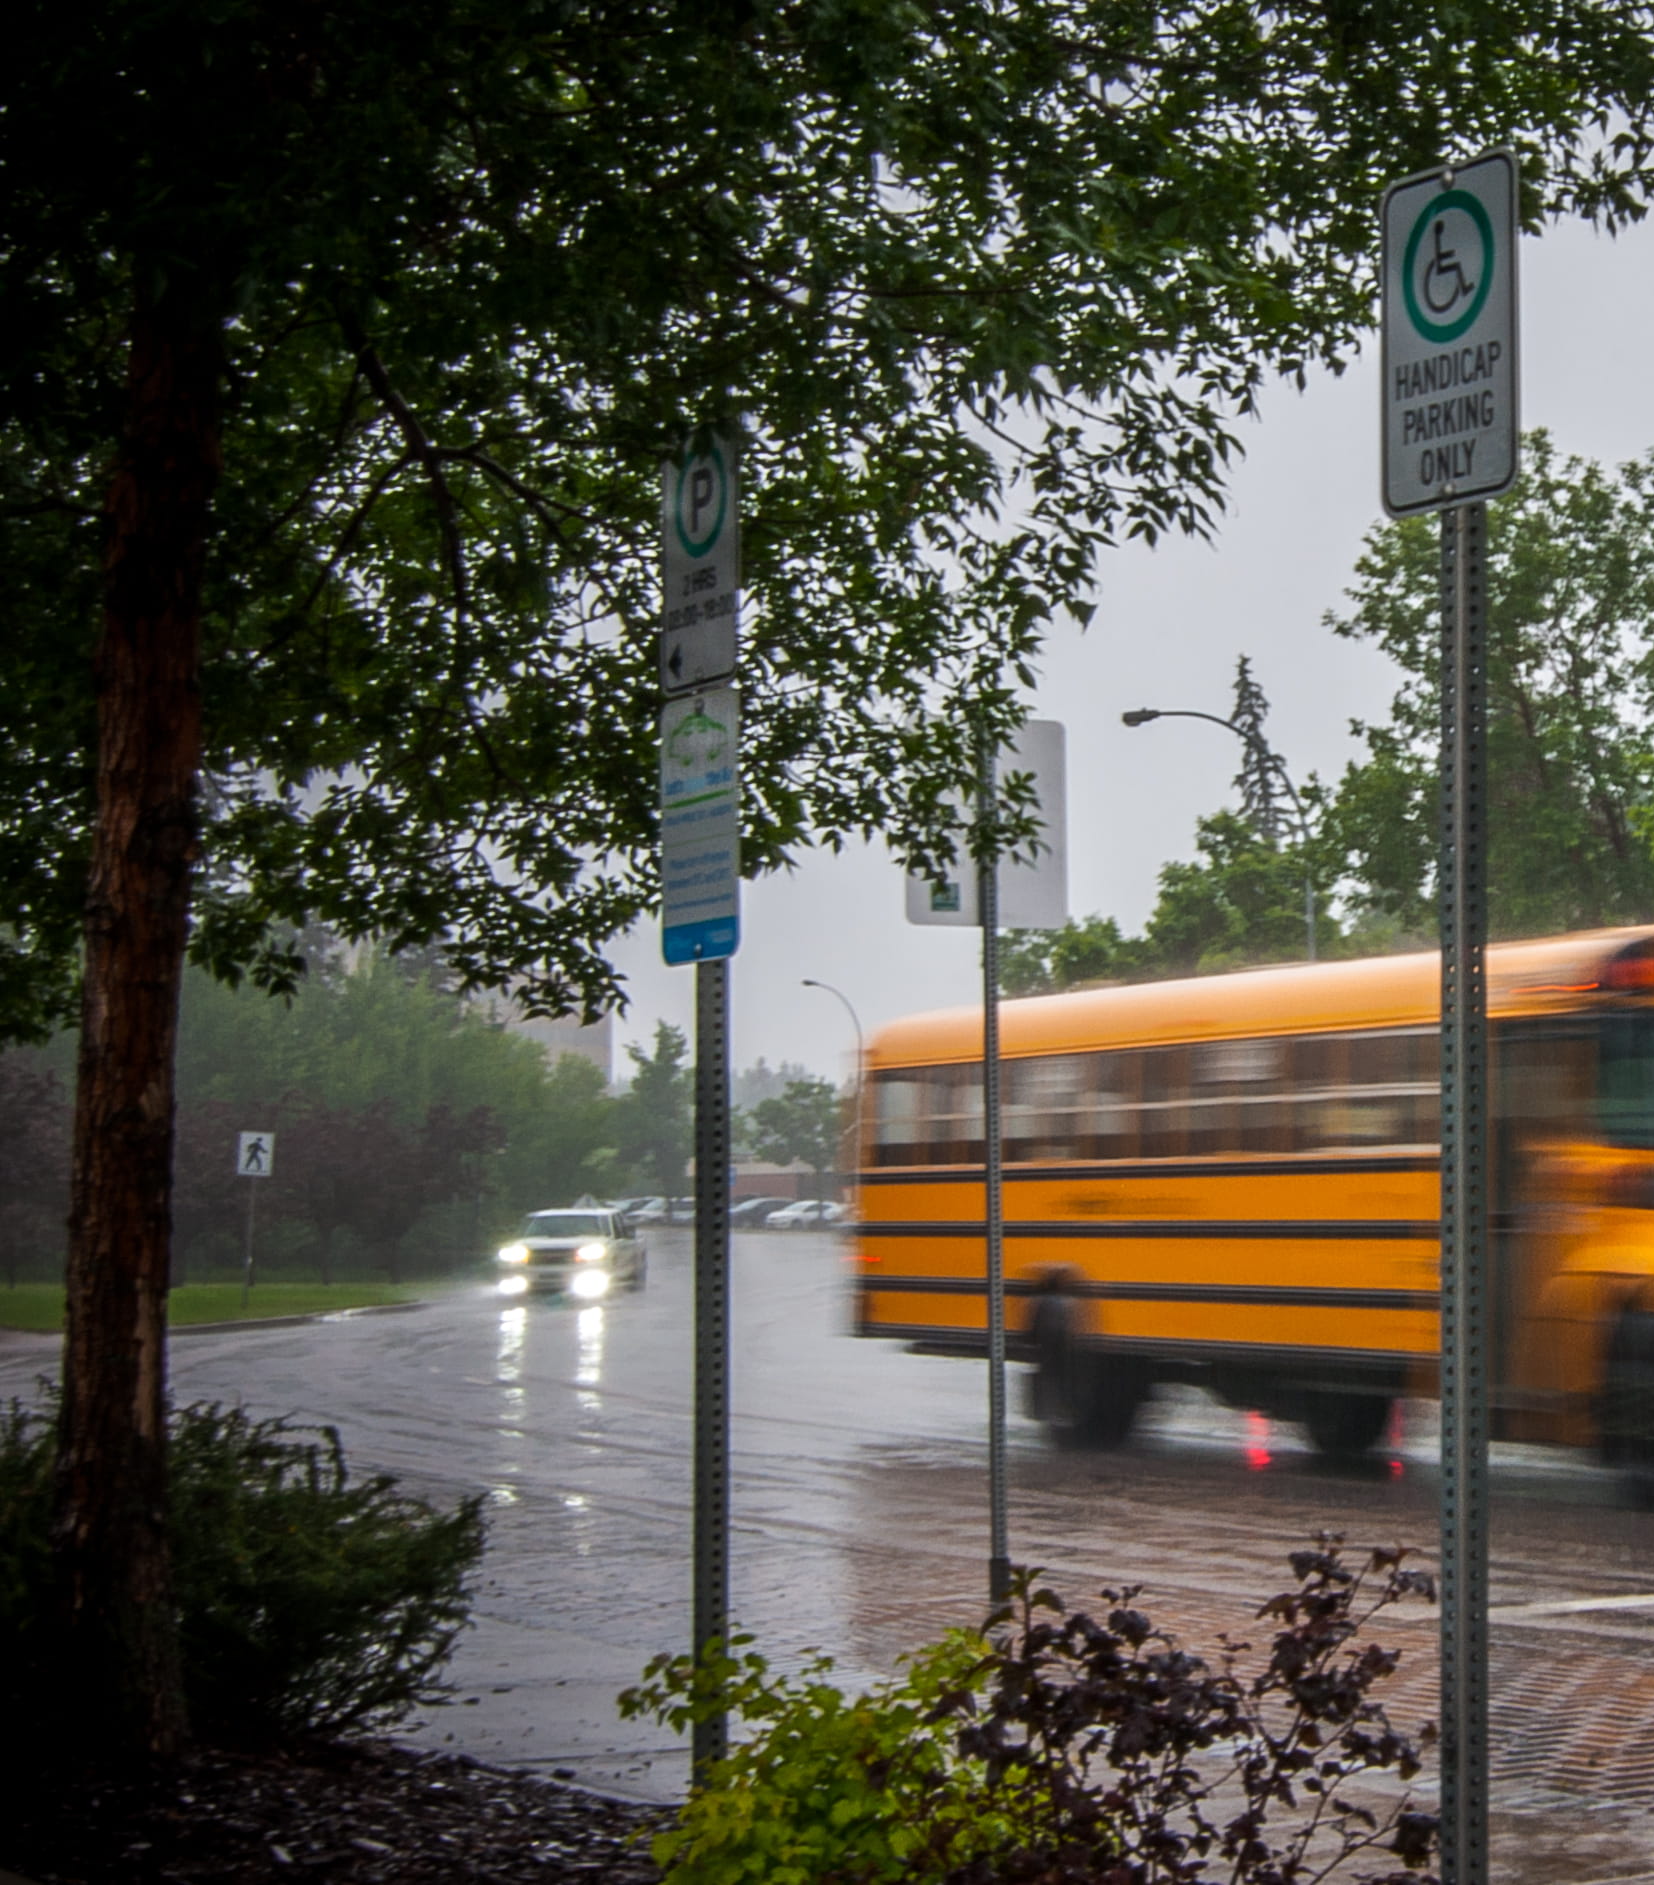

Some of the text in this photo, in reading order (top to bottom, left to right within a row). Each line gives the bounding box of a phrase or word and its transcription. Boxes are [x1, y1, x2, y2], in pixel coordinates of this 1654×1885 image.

[1395, 340, 1501, 400] HANDICAP
[1403, 390, 1494, 445] PARKING
[1420, 438, 1476, 486] ONLY
[691, 468, 712, 533] P
